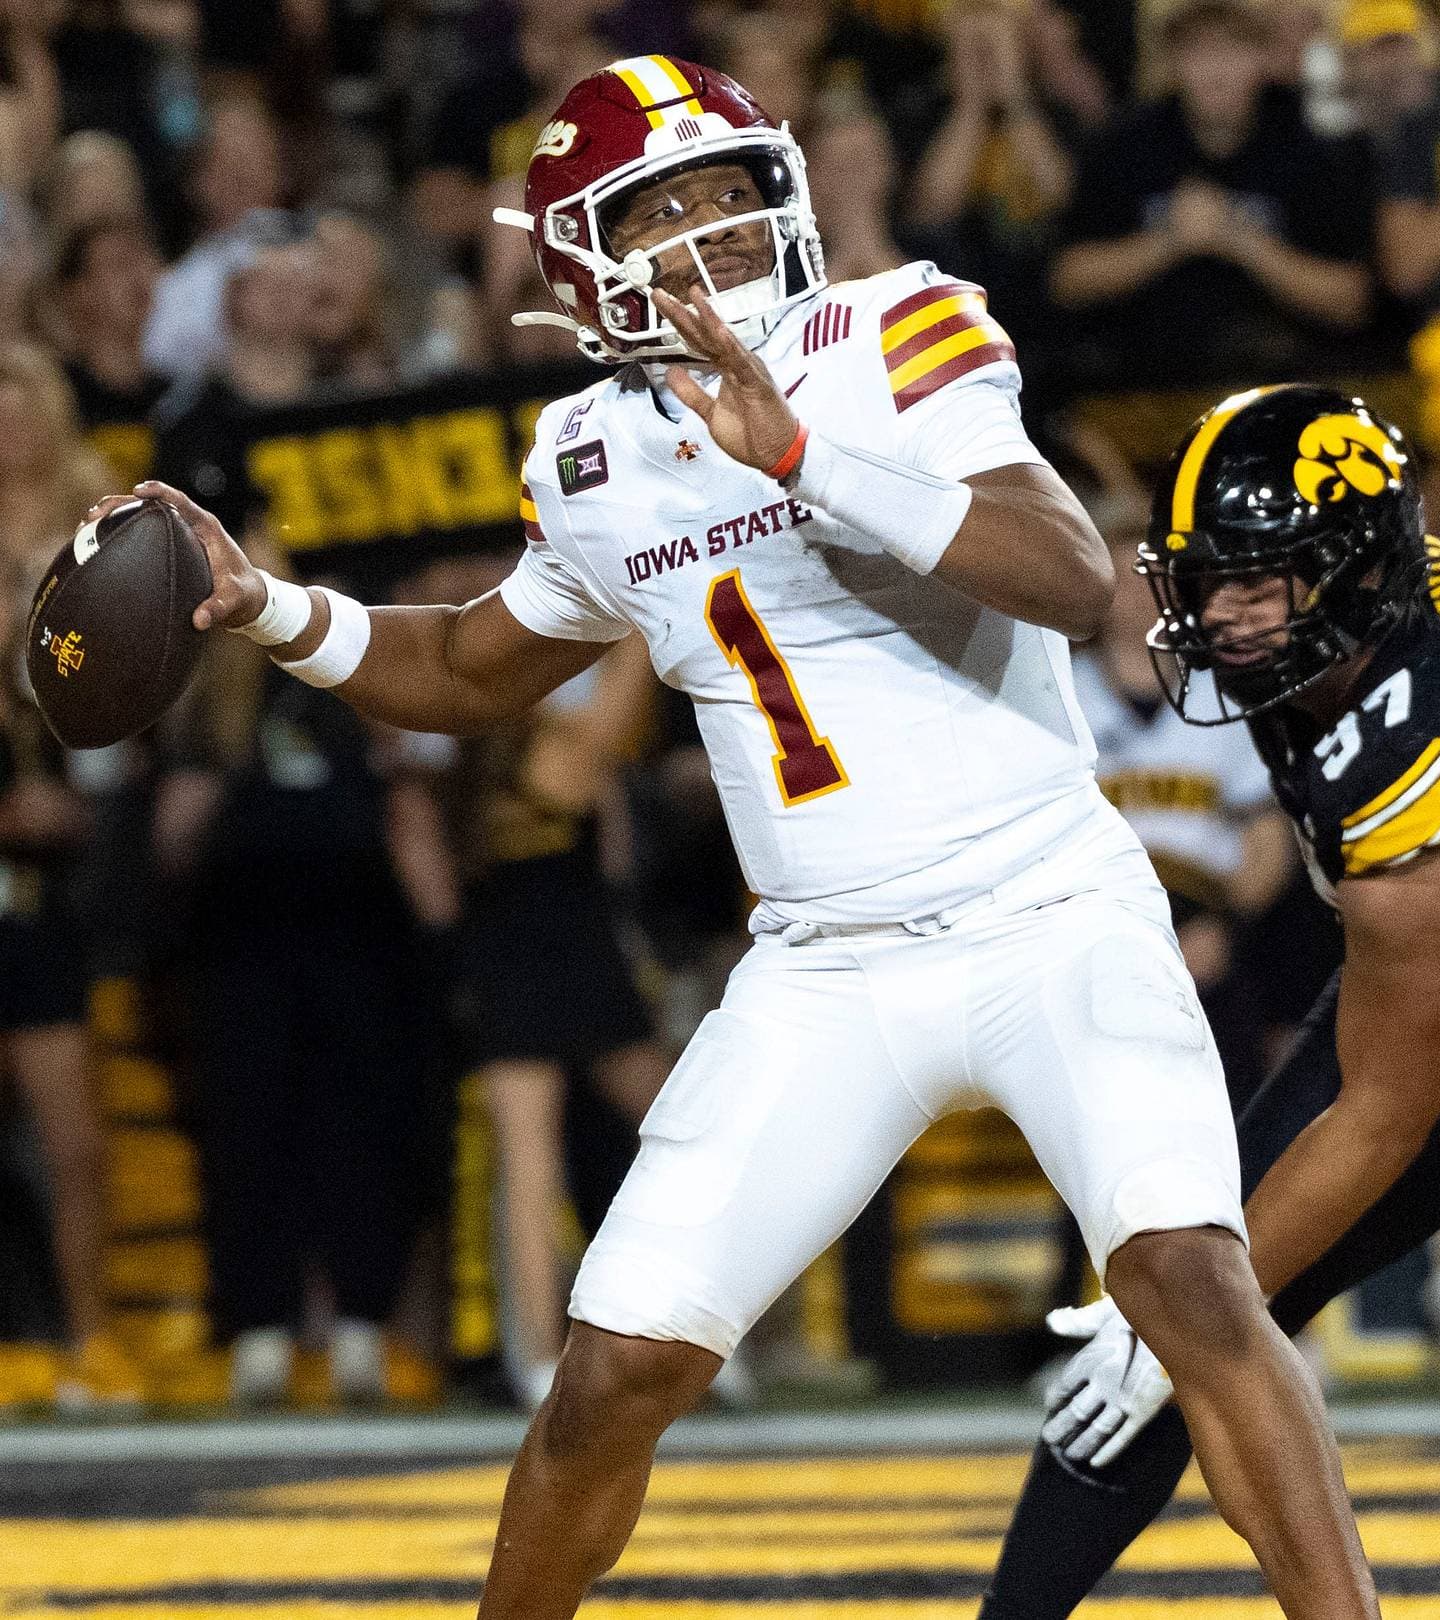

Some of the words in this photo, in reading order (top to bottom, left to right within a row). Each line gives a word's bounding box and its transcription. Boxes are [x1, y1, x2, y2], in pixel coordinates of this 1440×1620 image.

[624, 535, 700, 586] IOWA
[706, 496, 814, 557] STATE
[57, 630, 83, 677] STATE
[703, 566, 852, 809] 1
[1312, 667, 1413, 781] 97
